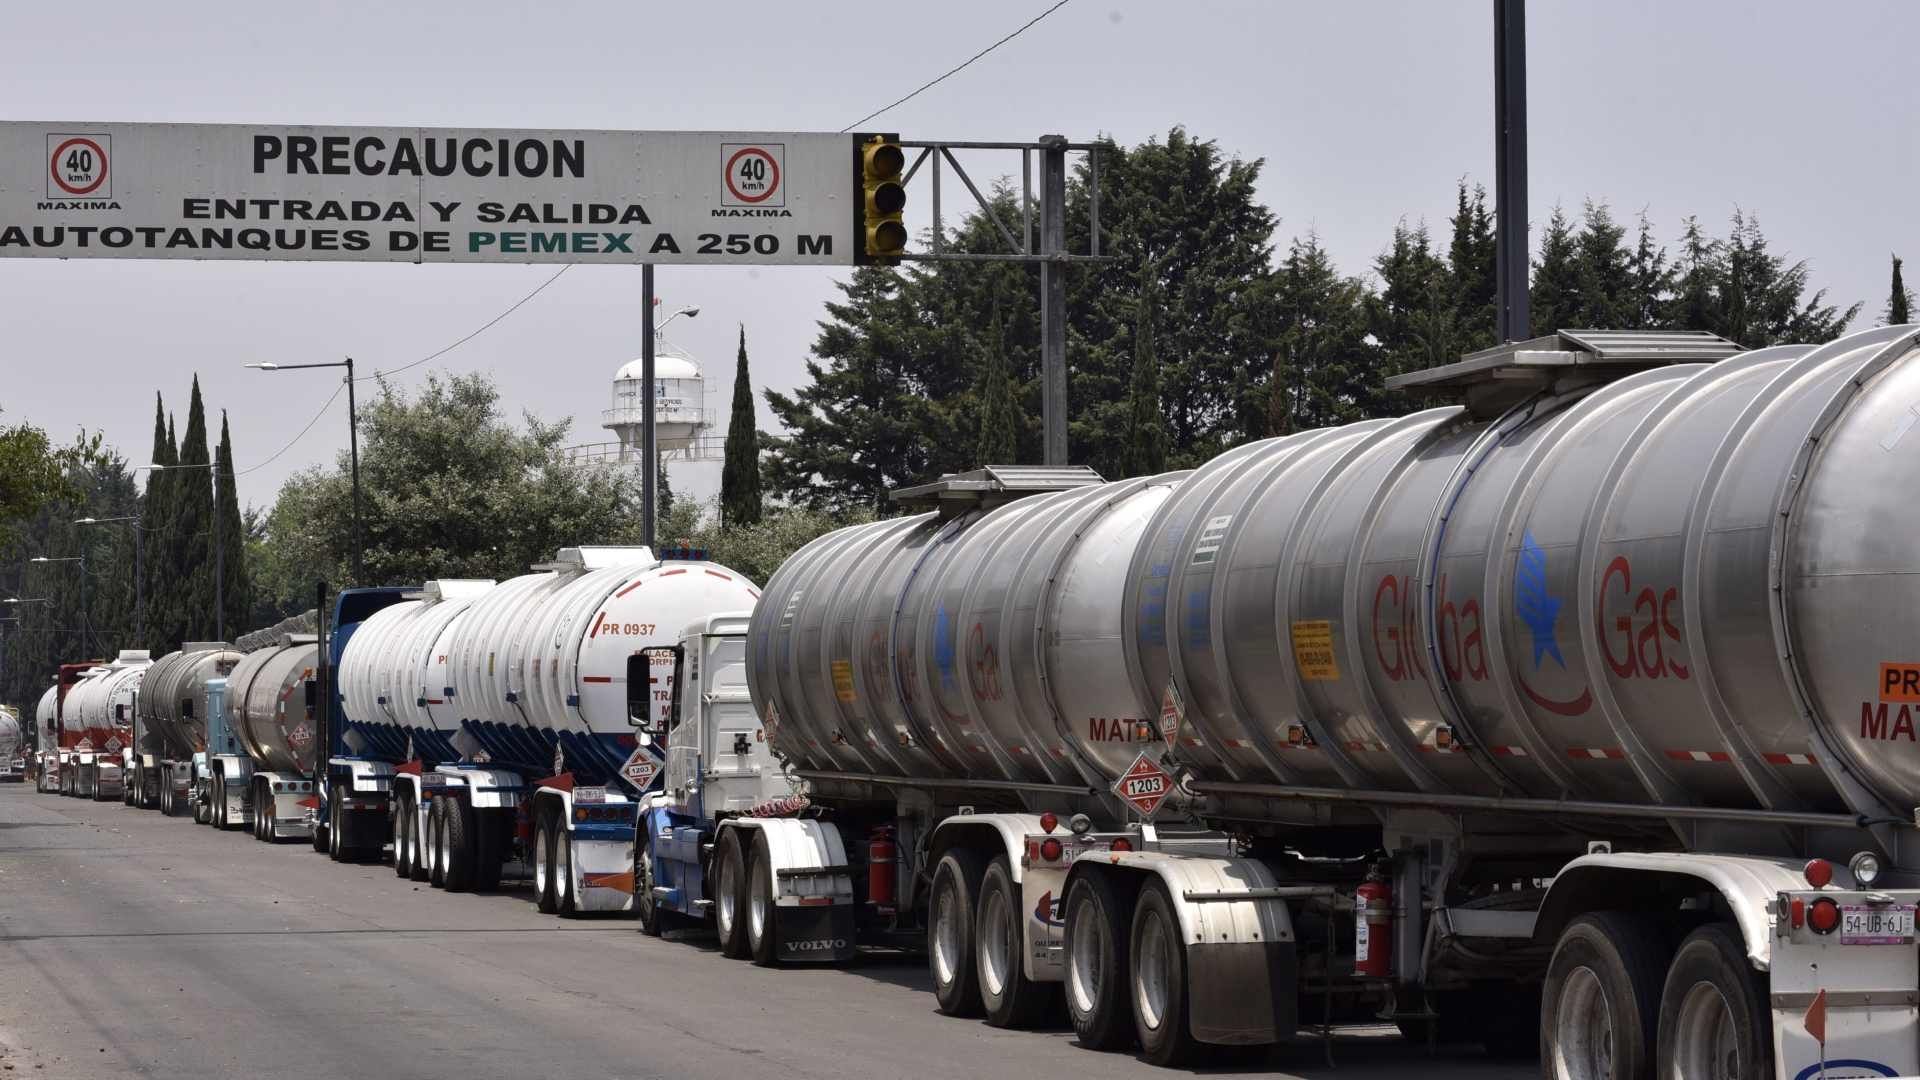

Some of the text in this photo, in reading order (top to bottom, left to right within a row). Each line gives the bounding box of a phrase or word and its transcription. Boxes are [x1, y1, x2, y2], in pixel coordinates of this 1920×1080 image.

[66, 149, 92, 173] 40
[252, 134, 585, 179] PRECAUCION
[68, 173, 92, 183] km/h
[740, 158, 765, 181] 40
[742, 181, 765, 191] km/h
[37, 202, 122, 210] MAXIMA
[183, 198, 652, 224] ENTRADA Y SALIDA
[711, 208, 793, 217] MAXIMA
[0, 226, 833, 255] AUTOTANQUES DE PEMEX A 250 M
[1599, 555, 1689, 680] Gas
[602, 623, 655, 636] PR 0937
[1884, 668, 1920, 695] PR
[1861, 702, 1920, 742] MA
[632, 766, 650, 774] 1203
[1129, 777, 1161, 794] 1203
[1846, 915, 1903, 934] 54-UB-6J
[784, 938, 847, 952] VOLVO
